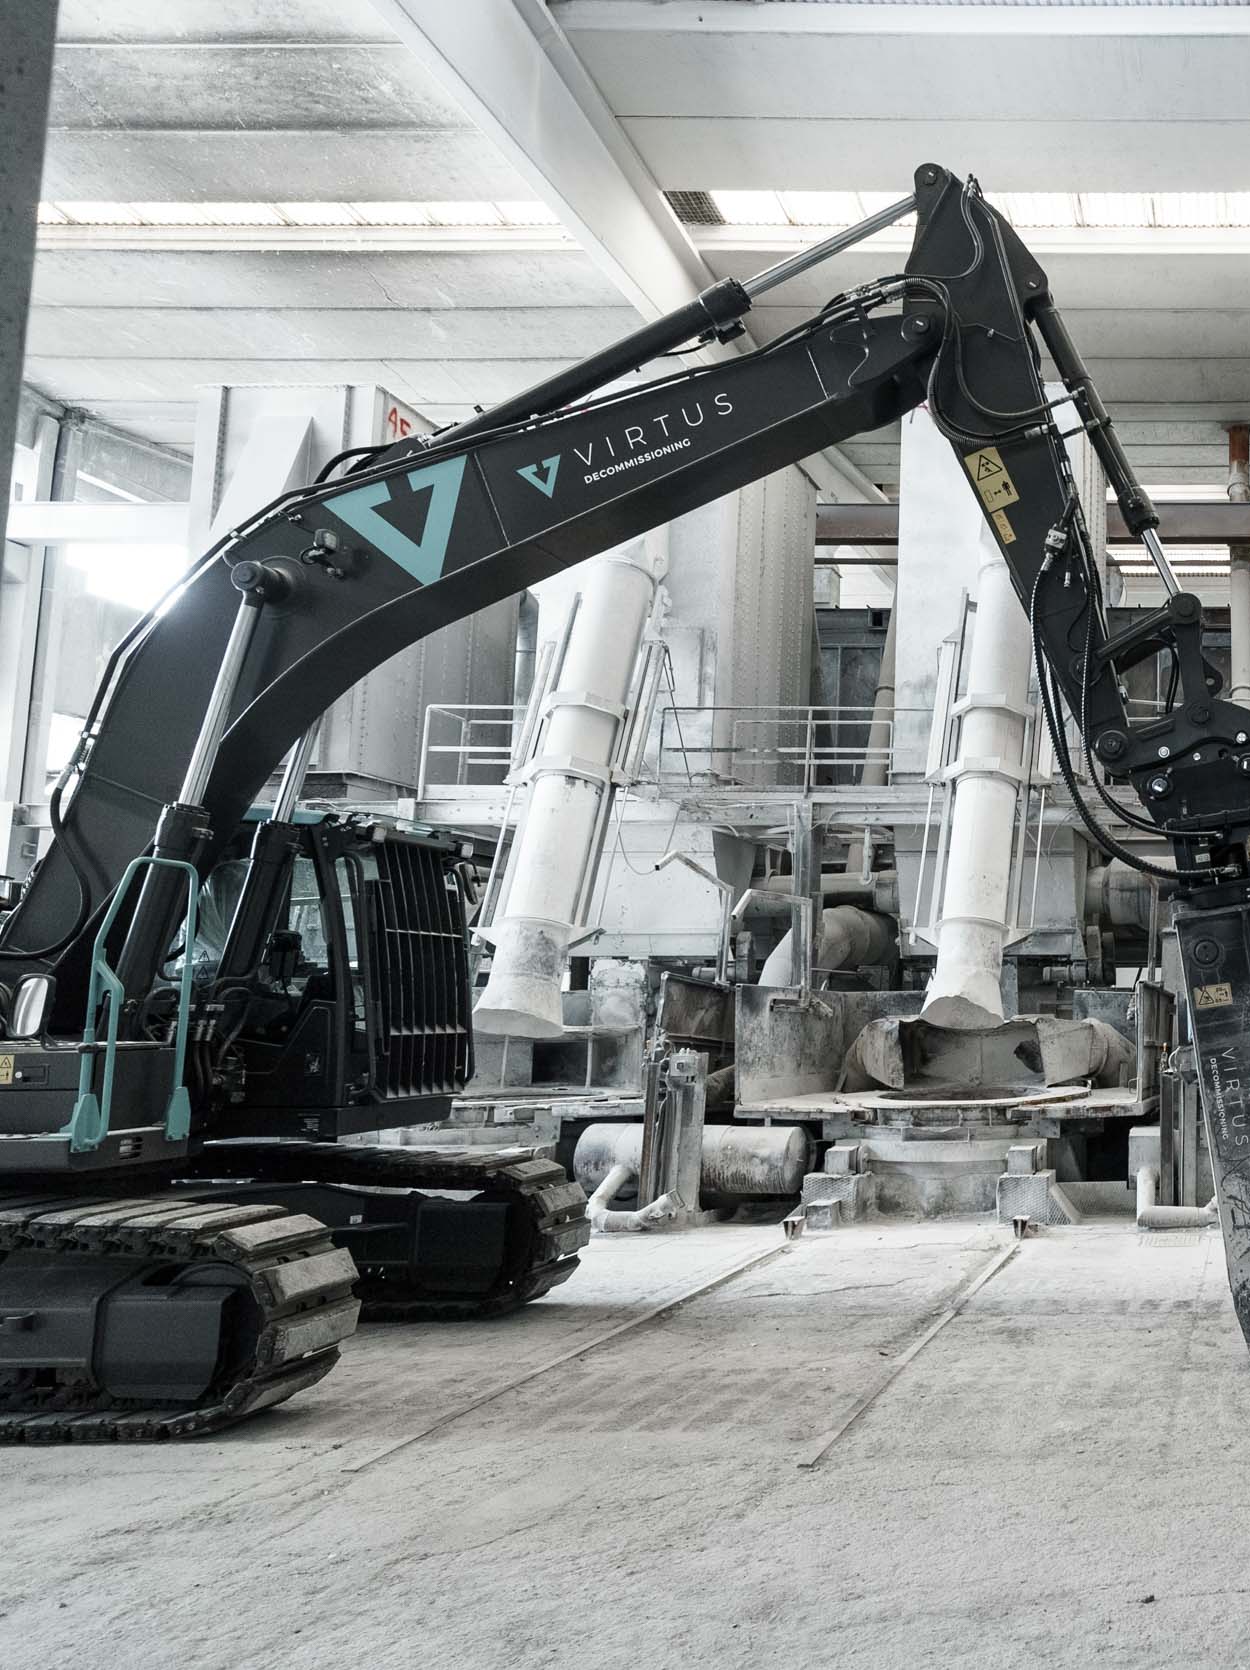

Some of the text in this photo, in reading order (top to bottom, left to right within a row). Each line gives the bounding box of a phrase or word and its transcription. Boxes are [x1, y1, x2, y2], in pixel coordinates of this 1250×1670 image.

[573, 392, 734, 467] VIRTUS
[583, 437, 692, 485] DECOMMISSIONING
[1209, 1057, 1230, 1141] DECOMMISSIONING
[1221, 1046, 1250, 1147] VIRTUS
